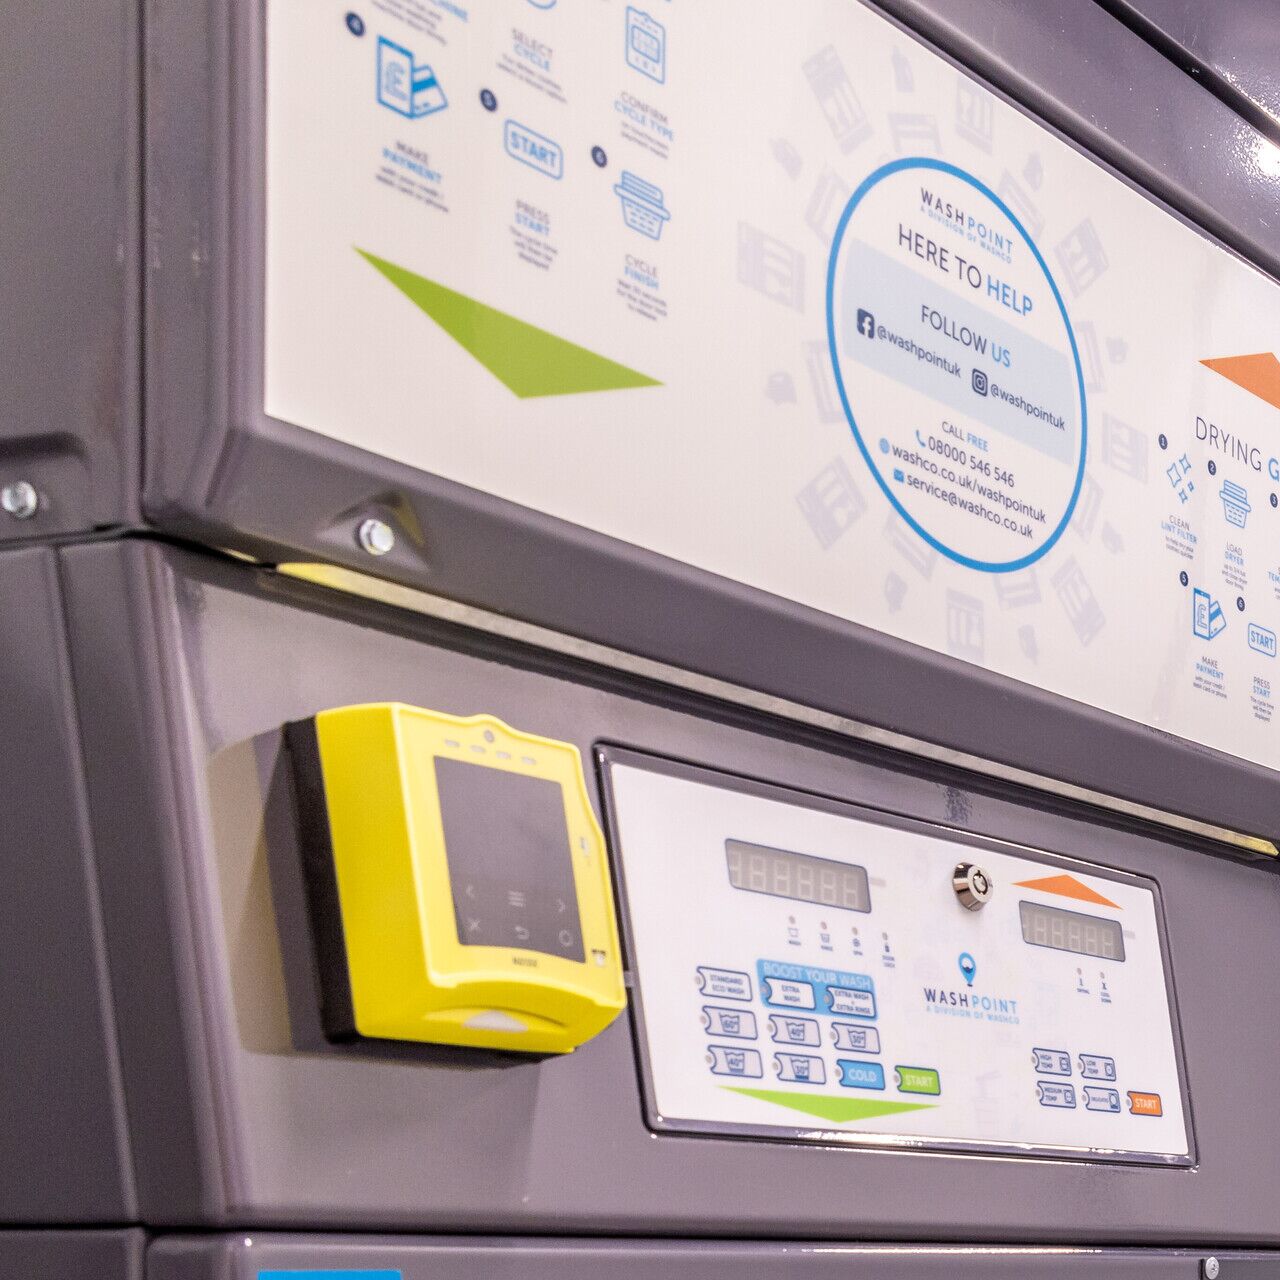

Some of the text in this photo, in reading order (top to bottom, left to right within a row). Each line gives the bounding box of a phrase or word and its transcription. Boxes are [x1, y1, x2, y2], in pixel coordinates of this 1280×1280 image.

[510, 131, 556, 168] START
[920, 187, 1013, 254] WASHPOINT
[928, 208, 964, 237] DIVISION
[979, 239, 1012, 264] WASHCO
[625, 254, 658, 277] CYCLE
[899, 223, 1033, 317] HERE TO HELP
[921, 305, 1011, 368] FOLLOW US
[877, 325, 961, 378] @washpointuk
[990, 383, 1065, 431] @washpointuk
[942, 421, 989, 452] CALL FREE
[1195, 416, 1262, 472] DRYING
[928, 436, 1015, 488] 08000 546 546
[892, 443, 1047, 524] washco.co.uk/washpointuk
[906, 473, 1033, 539] service@washco.co.uk
[1161, 521, 1197, 544] LINT FILTER
[1169, 515, 1190, 531] CLEAN
[1225, 551, 1244, 566] DRYER
[1226, 541, 1243, 556] LOAD
[1250, 630, 1274, 651] START
[1196, 663, 1224, 679] PAYMENT
[1202, 656, 1218, 669] MAKE
[1253, 676, 1270, 690] PRESS
[1253, 686, 1271, 698] START
[710, 974, 743, 985] STANDARD
[763, 962, 872, 989] BOOST YOUR WASH
[727, 986, 745, 995] WASH
[781, 984, 800, 993] EXTRA
[783, 995, 801, 1003] WASH
[834, 989, 869, 1000] EXTRA WASH
[924, 988, 1017, 1014] WASHPOINT
[934, 1006, 970, 1017] DIVISION
[987, 1014, 1020, 1024] WASHCO
[848, 1070, 876, 1082] COLD
[905, 1074, 934, 1088] START
[1135, 1098, 1157, 1109] START
